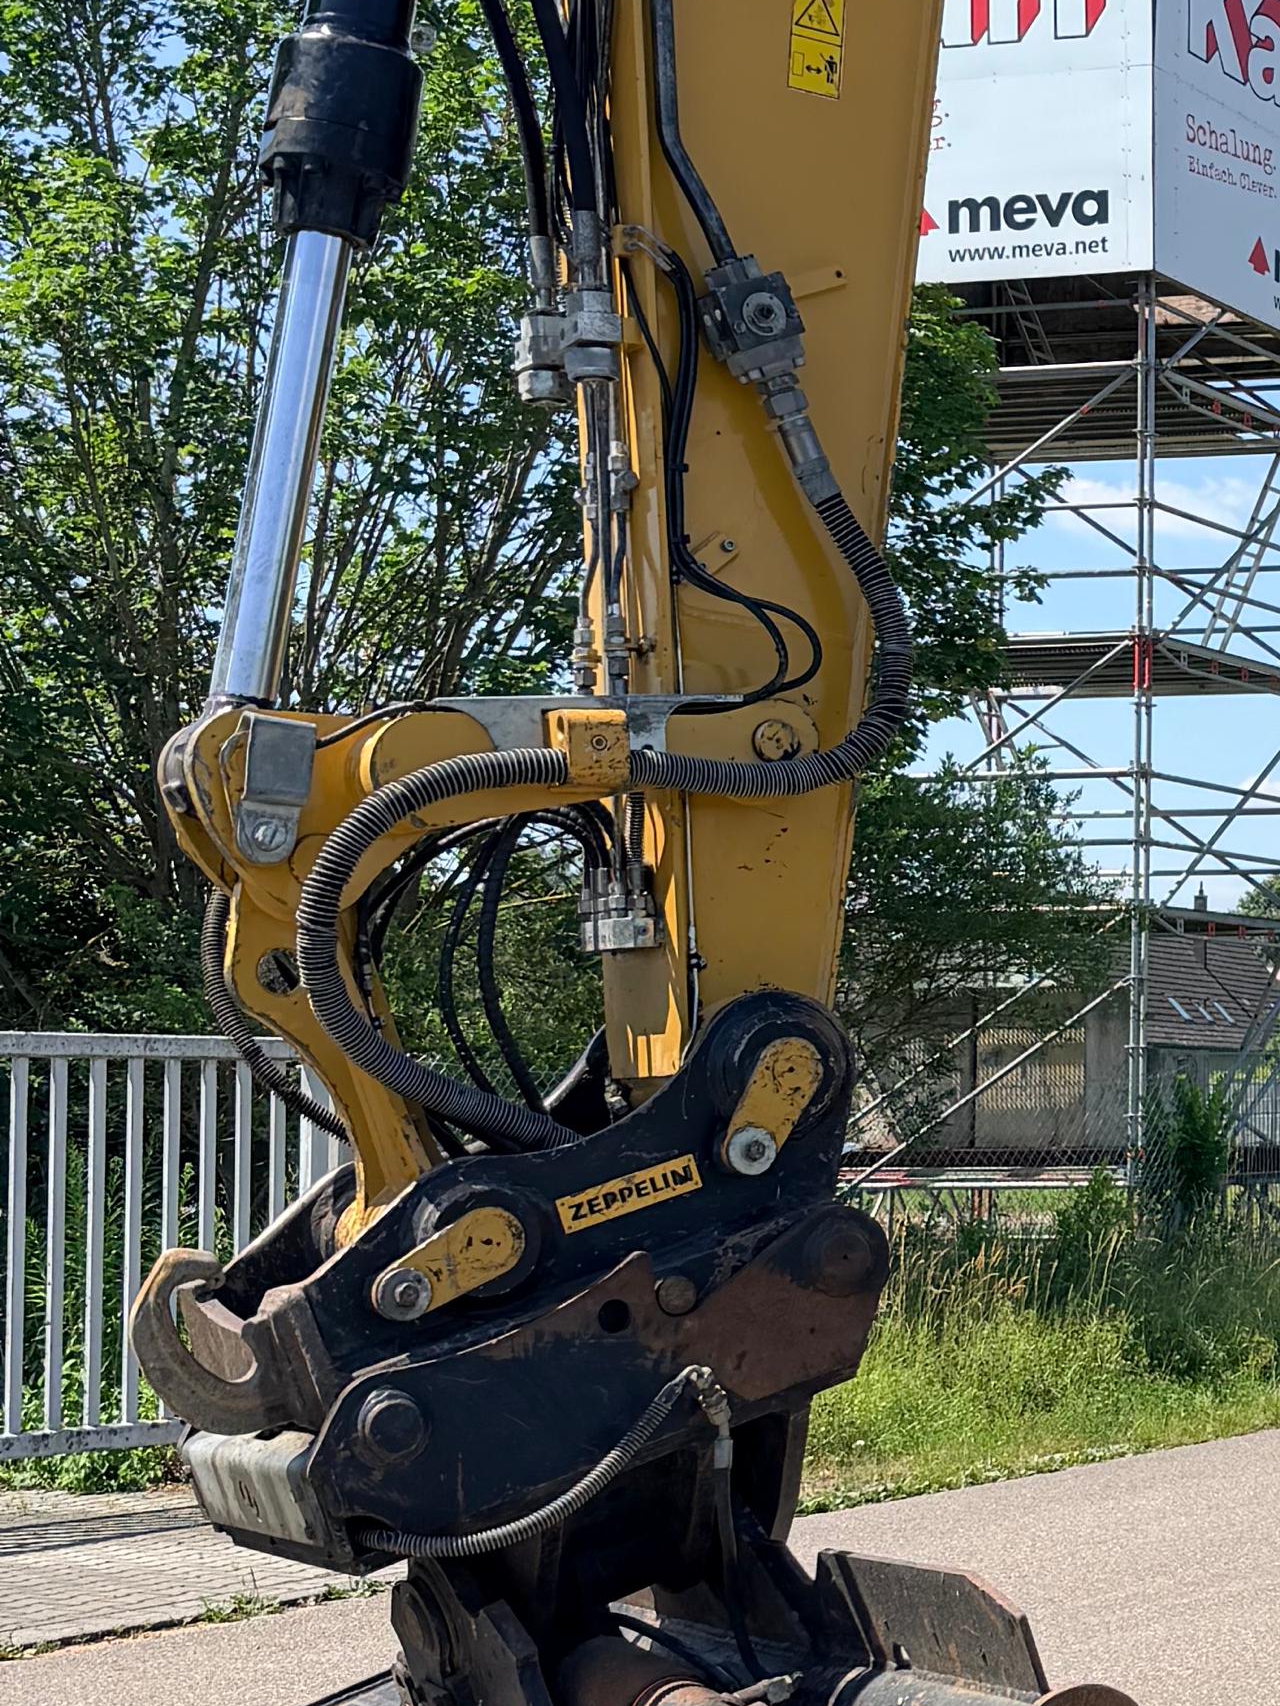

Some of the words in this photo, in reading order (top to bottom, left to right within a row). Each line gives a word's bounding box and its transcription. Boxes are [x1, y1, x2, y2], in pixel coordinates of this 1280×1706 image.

[1186, 113, 1277, 176] Schalung.
[948, 190, 1109, 234] meva
[948, 236, 1109, 263] www.meva.net
[568, 1163, 694, 1222] ZEPPELIN
